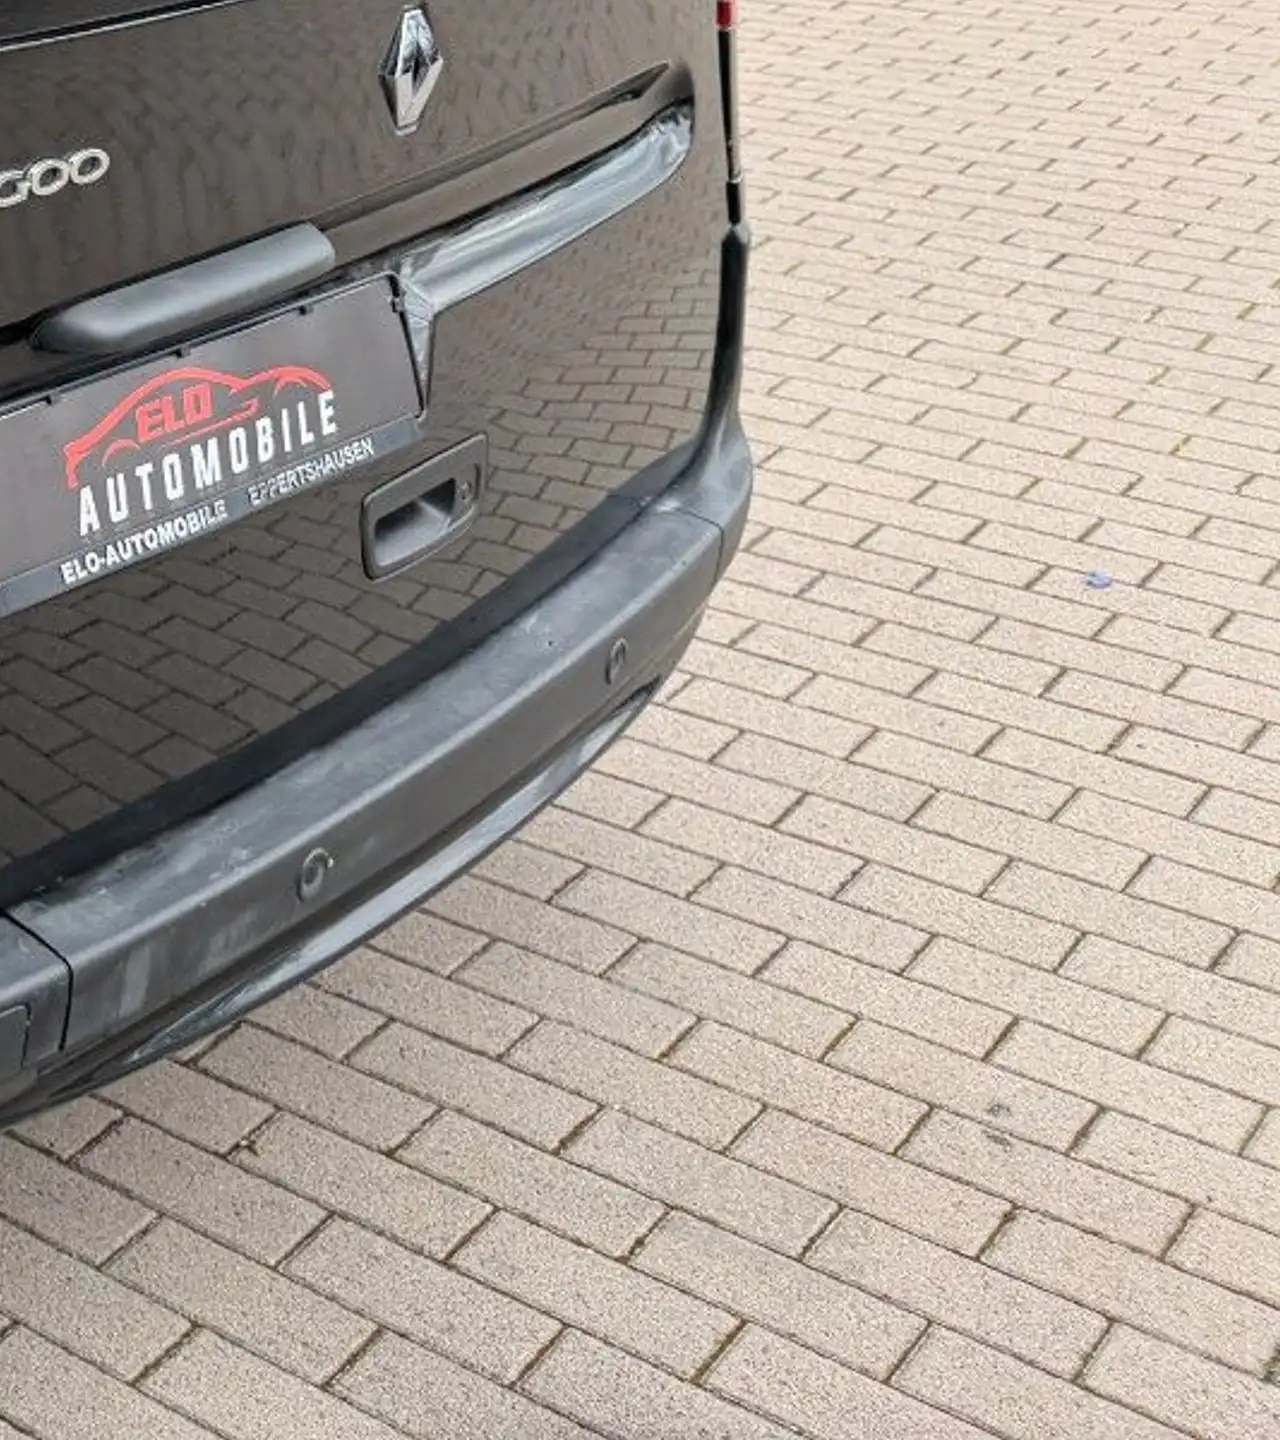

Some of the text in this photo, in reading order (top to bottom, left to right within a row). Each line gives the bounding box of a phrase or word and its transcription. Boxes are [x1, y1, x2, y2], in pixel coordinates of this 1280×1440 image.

[135, 381, 215, 443] ELO
[79, 389, 338, 537] AUTOMOBILE
[60, 498, 228, 586] ELO-AUTOMOBILE
